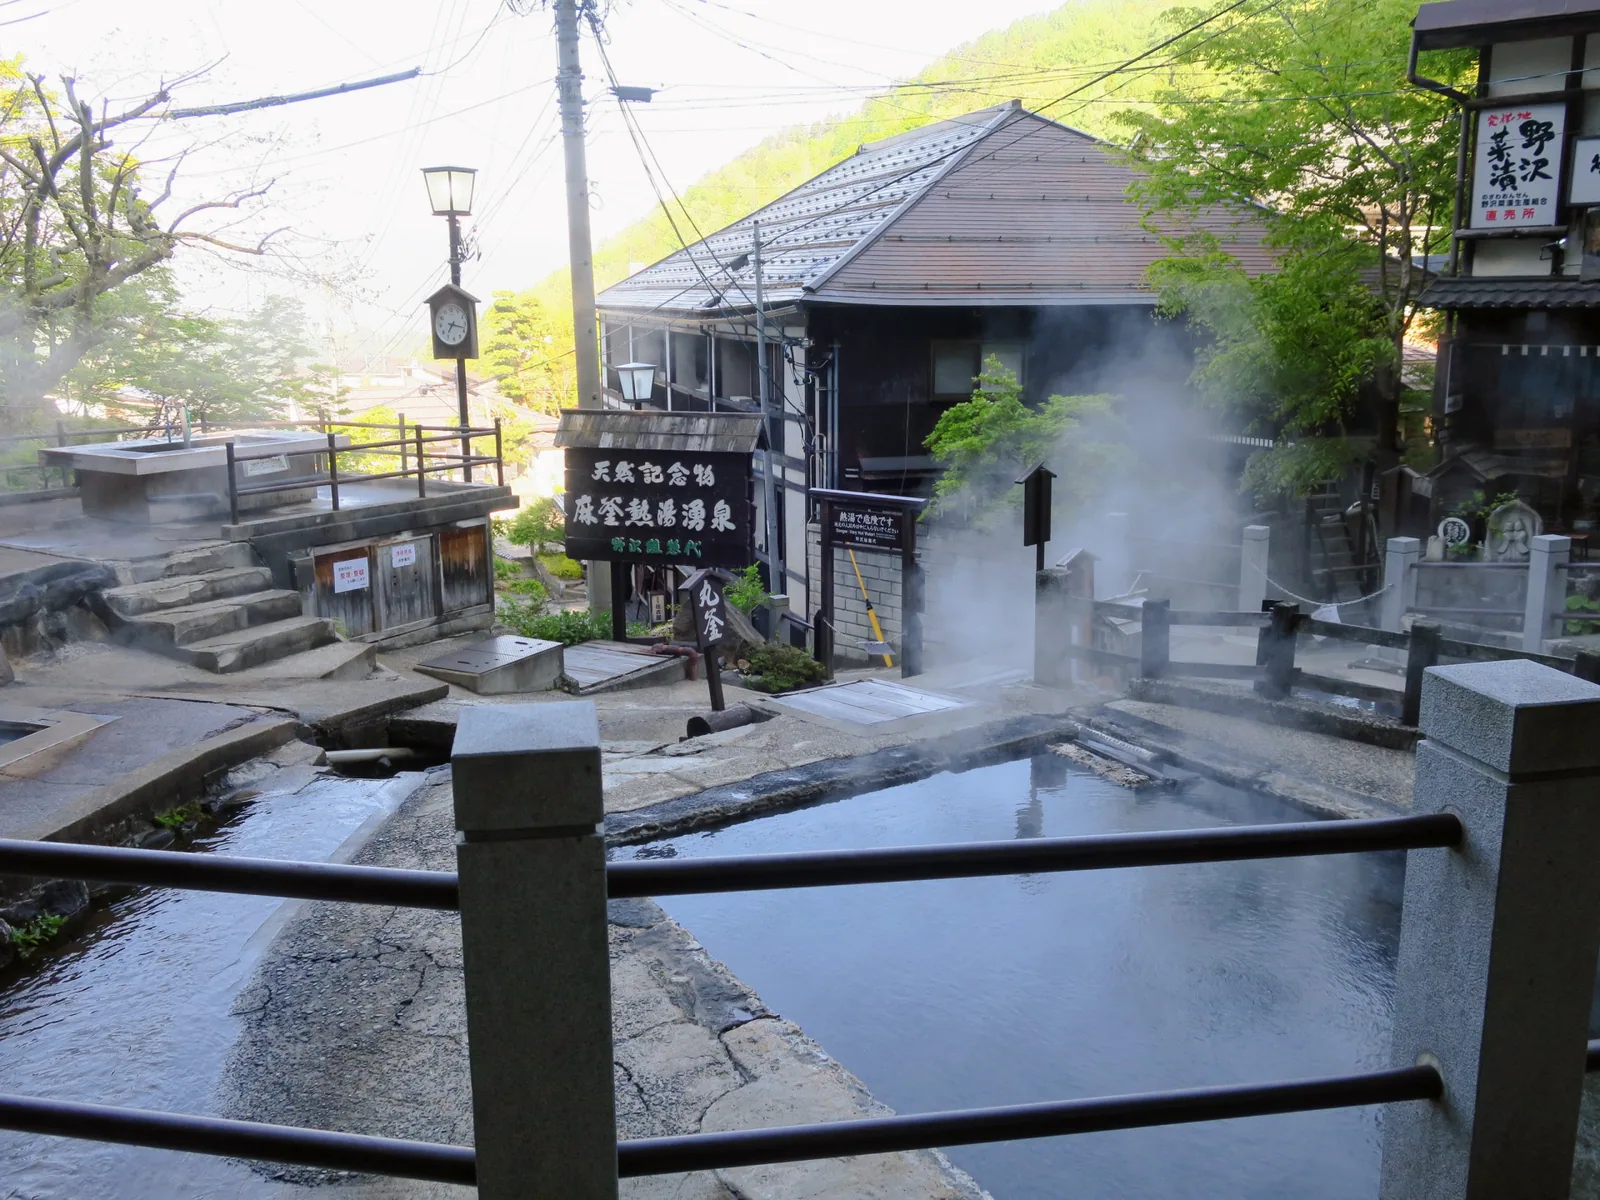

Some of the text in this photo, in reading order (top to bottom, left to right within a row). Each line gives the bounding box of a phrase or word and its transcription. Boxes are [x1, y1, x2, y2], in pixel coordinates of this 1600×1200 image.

[1485, 207, 1535, 221] 直売所
[591, 460, 716, 487] 天然記念物
[839, 511, 894, 528] 熱湯で危険です
[699, 579, 725, 641] 丸釜
